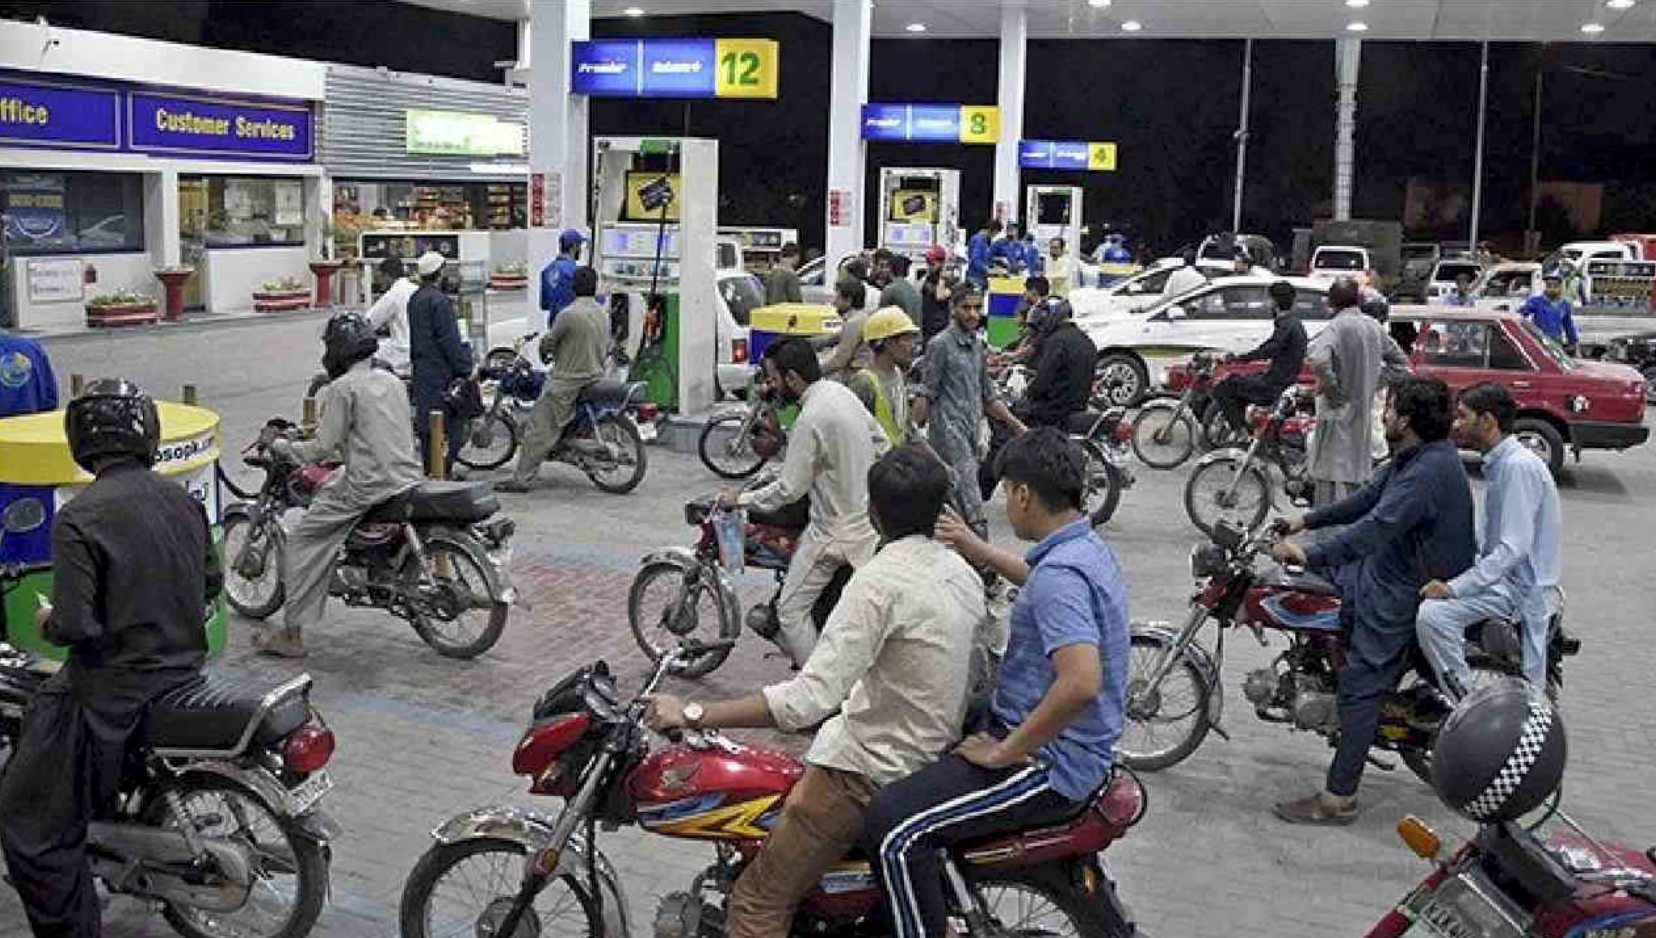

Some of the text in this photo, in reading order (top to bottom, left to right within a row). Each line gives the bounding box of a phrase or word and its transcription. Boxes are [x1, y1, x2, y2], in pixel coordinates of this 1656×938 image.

[721, 52, 760, 85] 12
[156, 107, 294, 141] Customer Services
[970, 112, 986, 135] 8
